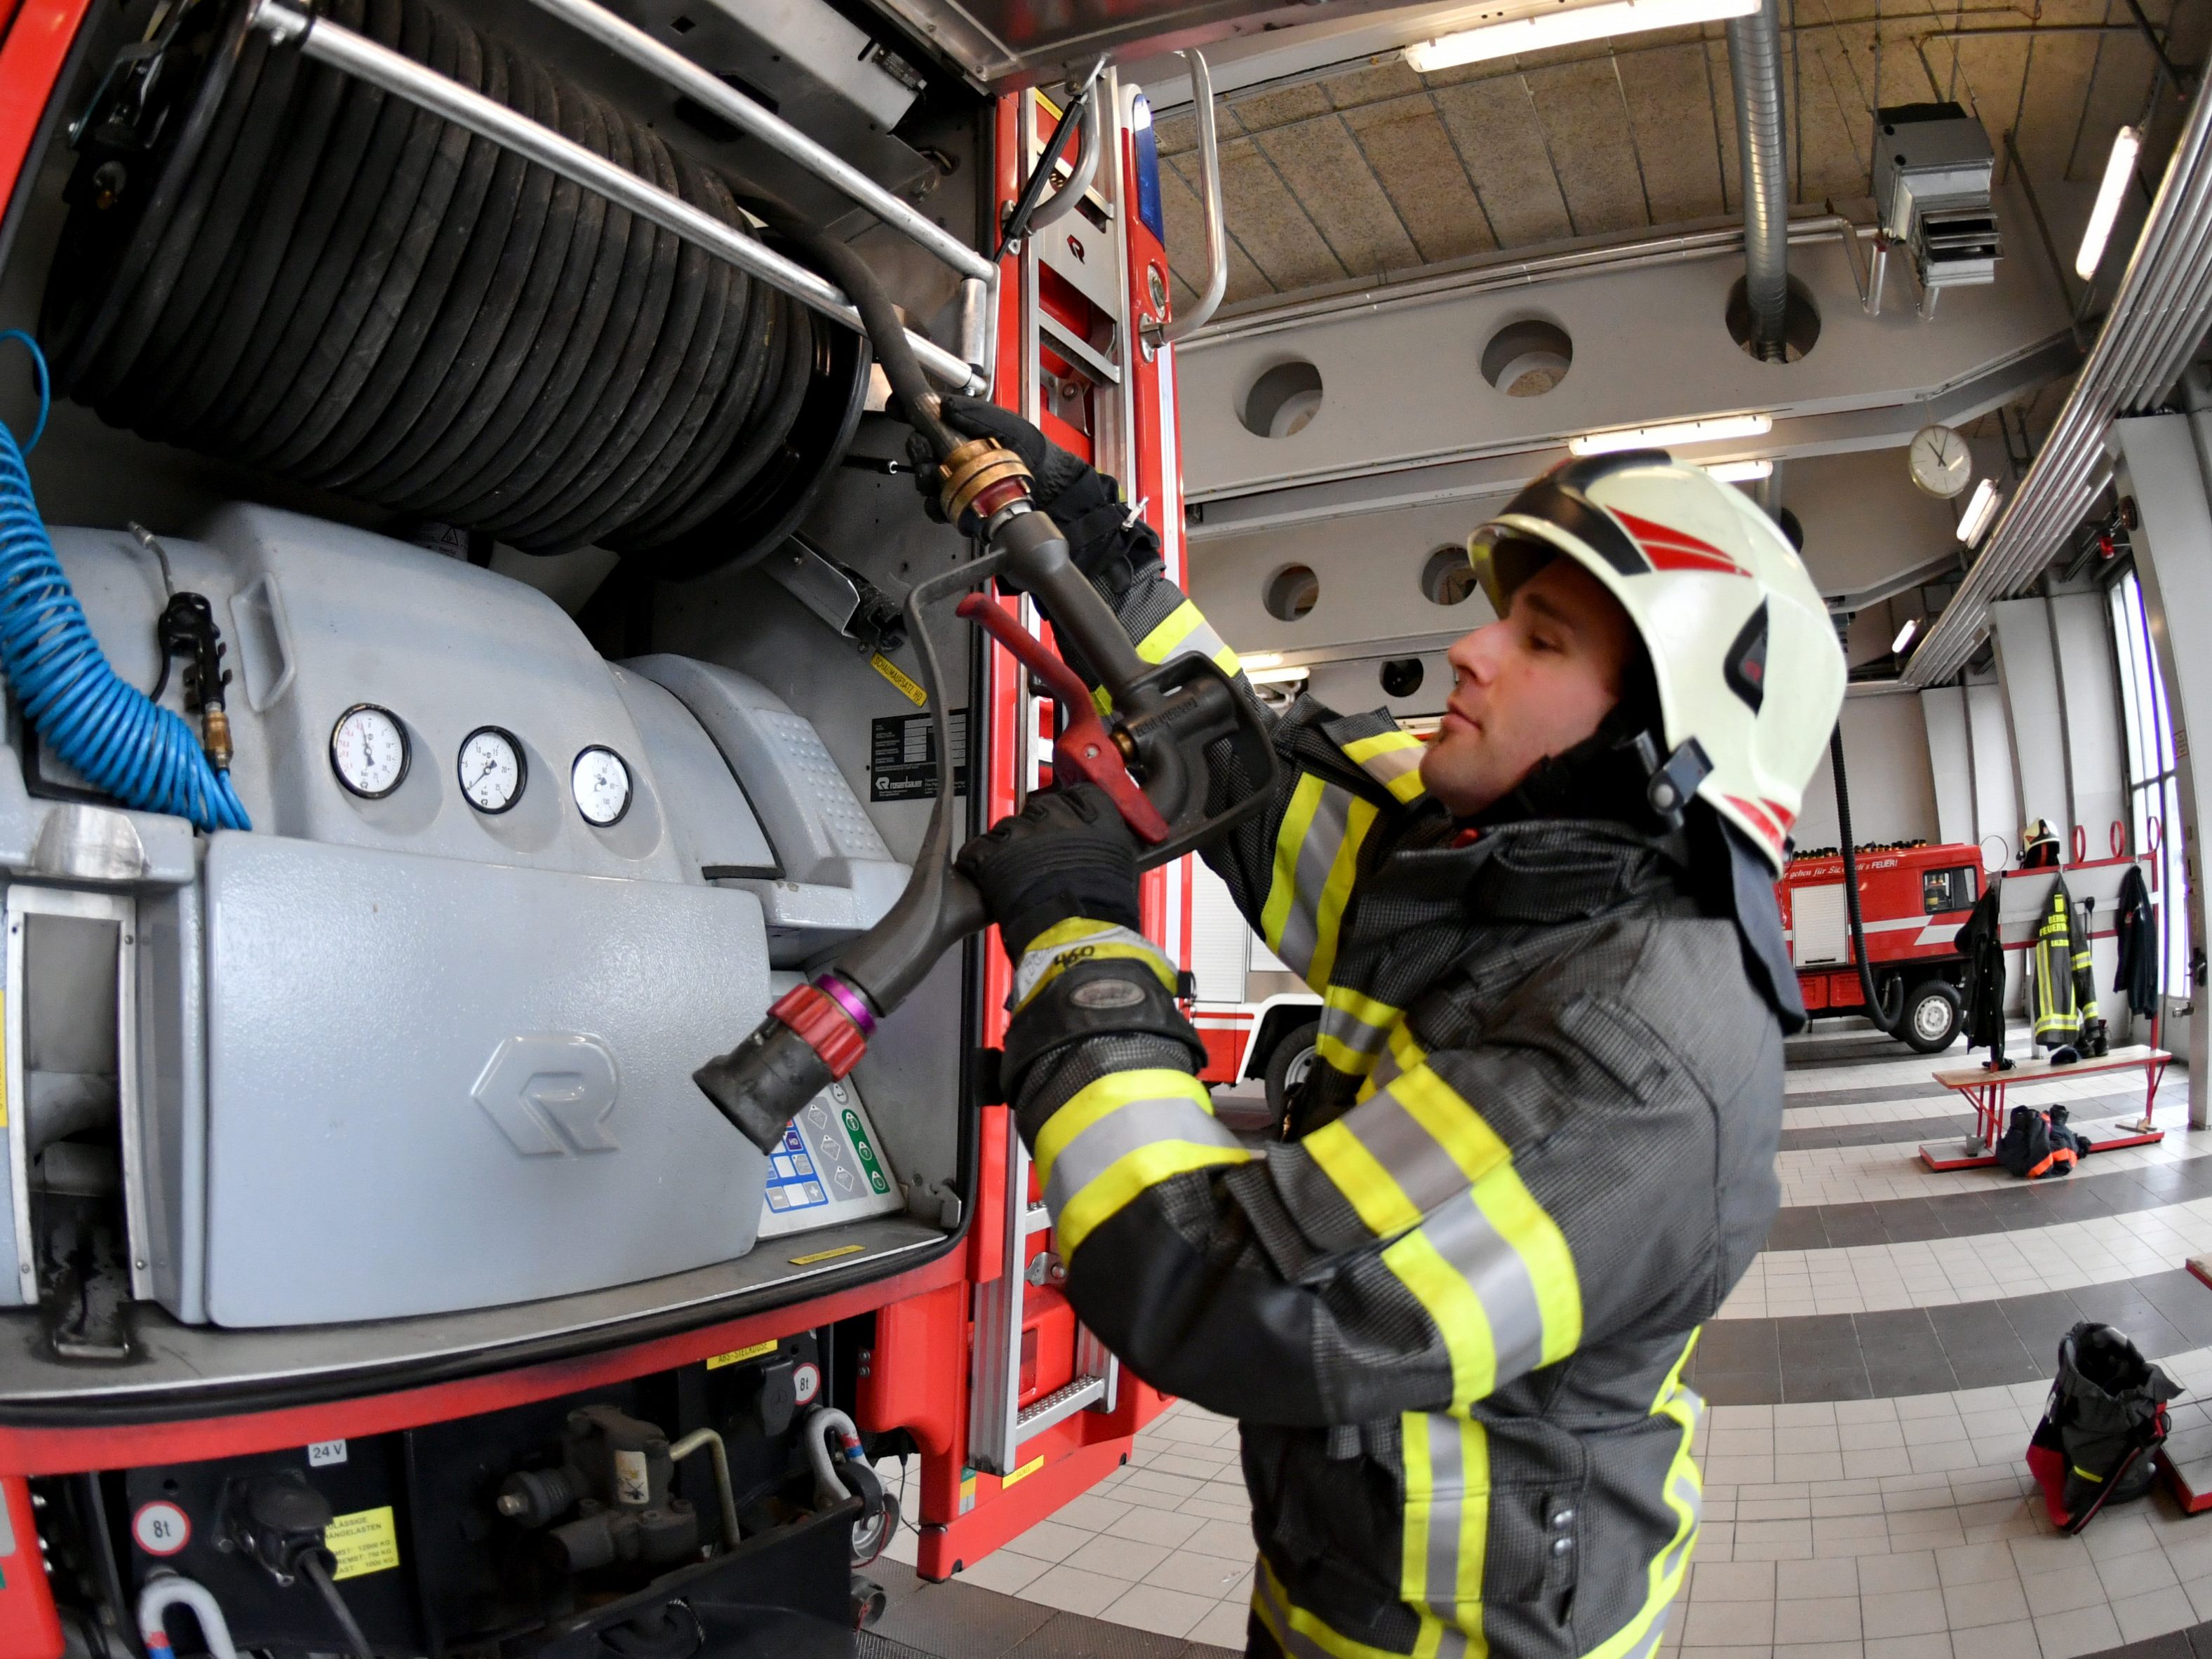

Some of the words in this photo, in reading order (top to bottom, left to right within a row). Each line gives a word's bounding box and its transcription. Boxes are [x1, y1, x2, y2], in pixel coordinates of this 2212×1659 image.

[873, 654, 913, 694] SCHAUMAUFSATZ
[1813, 867, 1826, 877] für
[1871, 859, 1898, 870] FEUER!
[800, 1377, 809, 1391] 8t
[314, 1446, 330, 1459] 24
[333, 1444, 342, 1456] V
[153, 1520, 170, 1538] 8t
